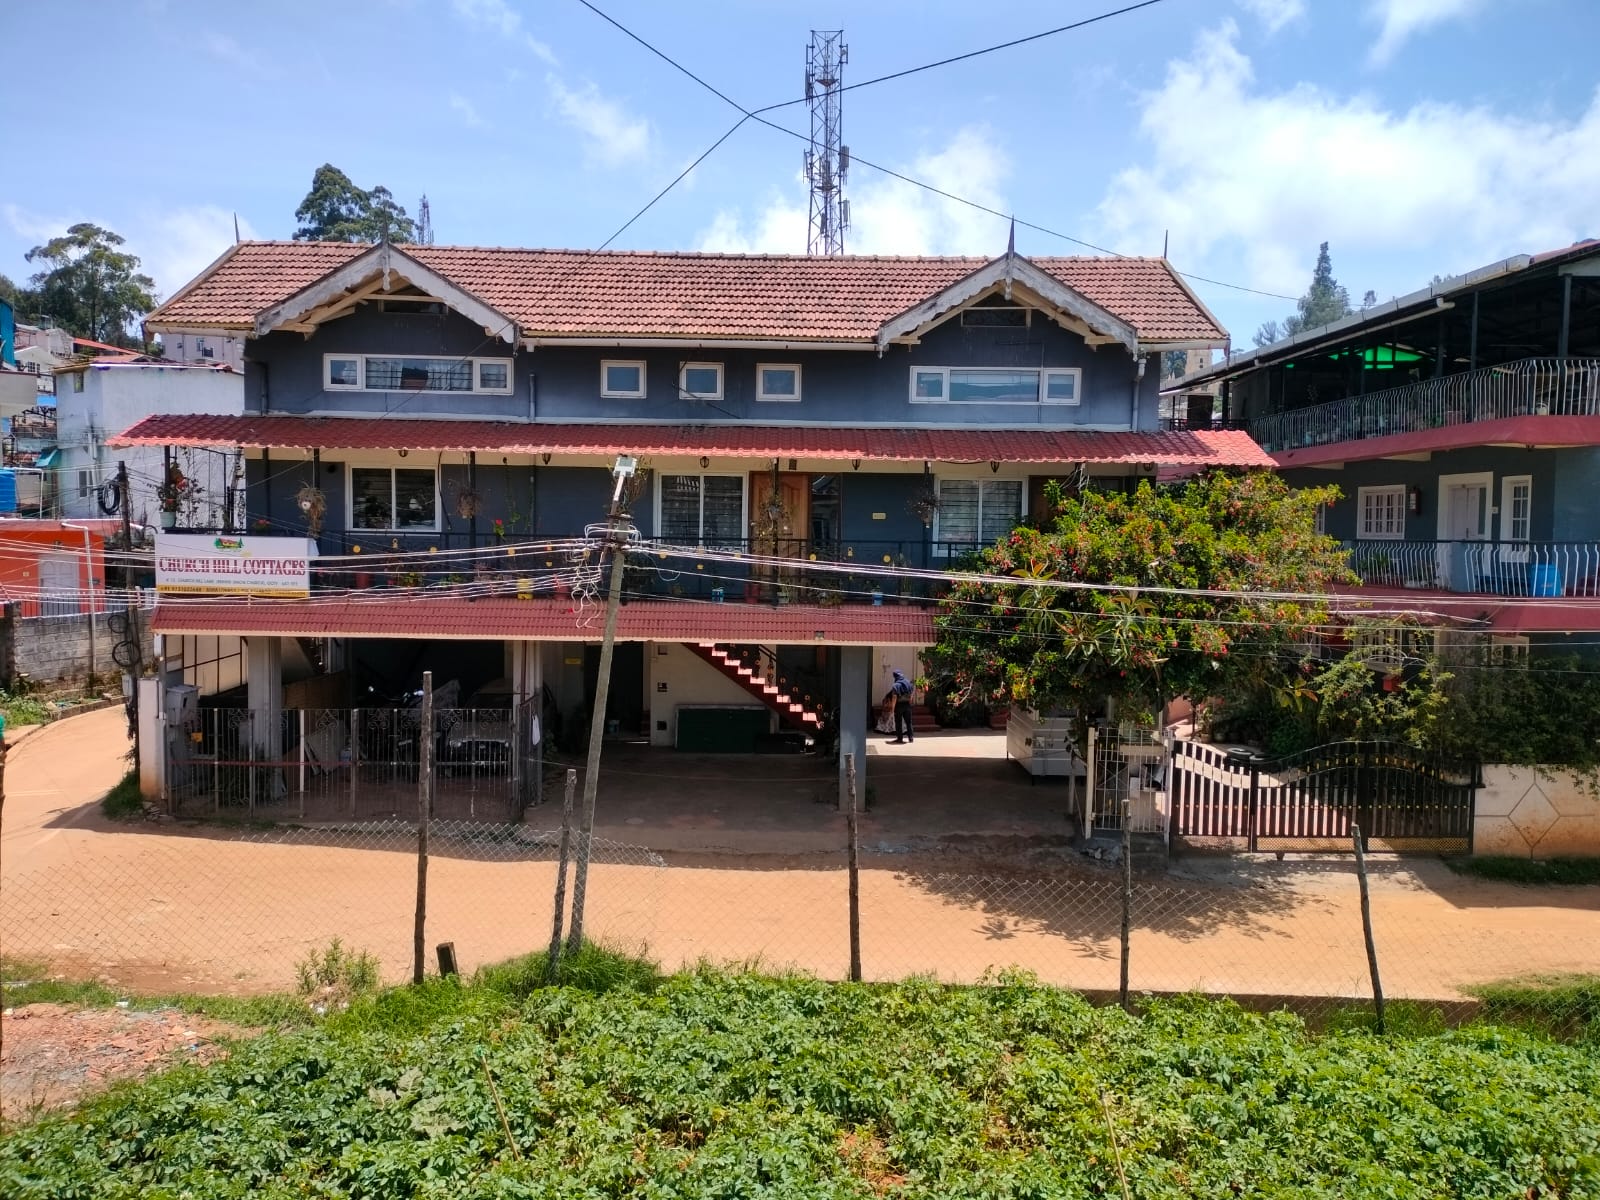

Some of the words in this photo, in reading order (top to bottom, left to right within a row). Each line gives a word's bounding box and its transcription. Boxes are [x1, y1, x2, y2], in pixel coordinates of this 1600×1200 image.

[159, 557, 209, 573] CHURCH
[213, 558, 241, 574] HILL
[243, 559, 306, 576] COTTAGES
